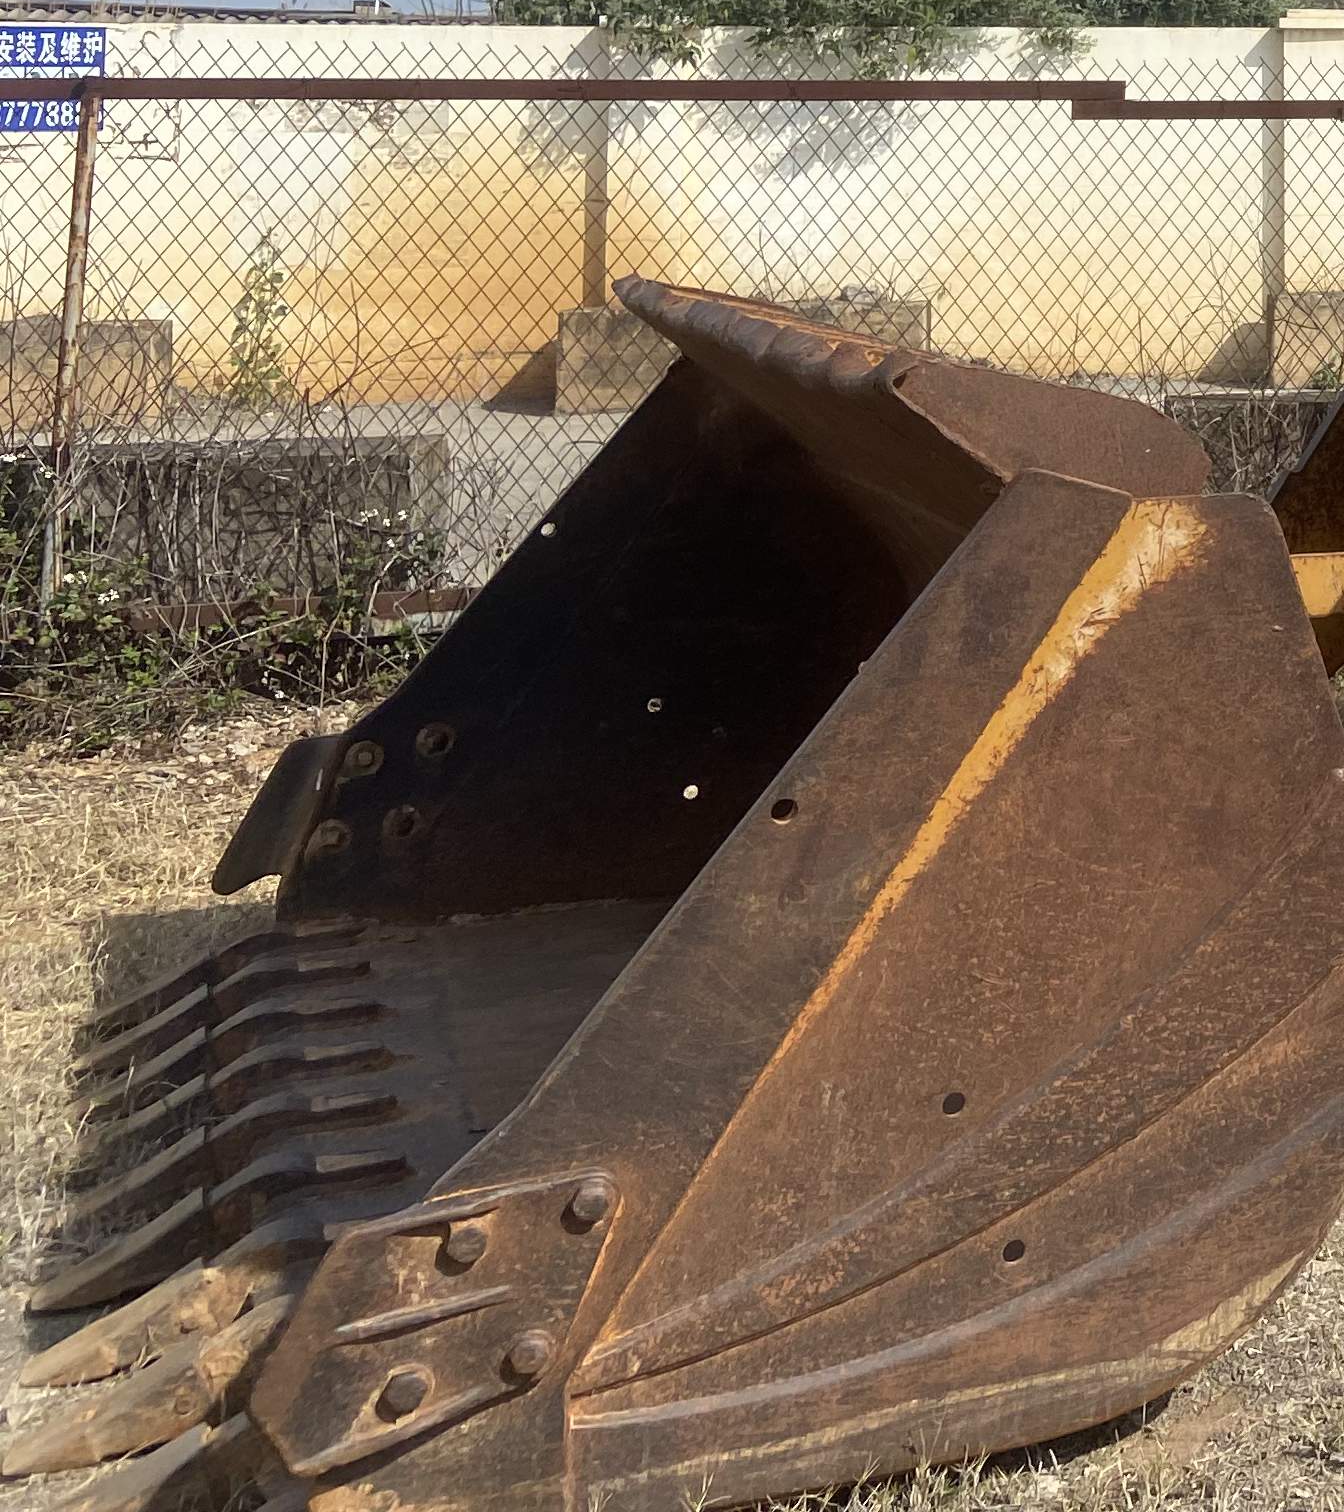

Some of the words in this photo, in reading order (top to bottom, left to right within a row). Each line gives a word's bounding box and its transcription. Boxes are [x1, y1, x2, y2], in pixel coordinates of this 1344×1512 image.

[0, 31, 103, 65] 安装及维护
